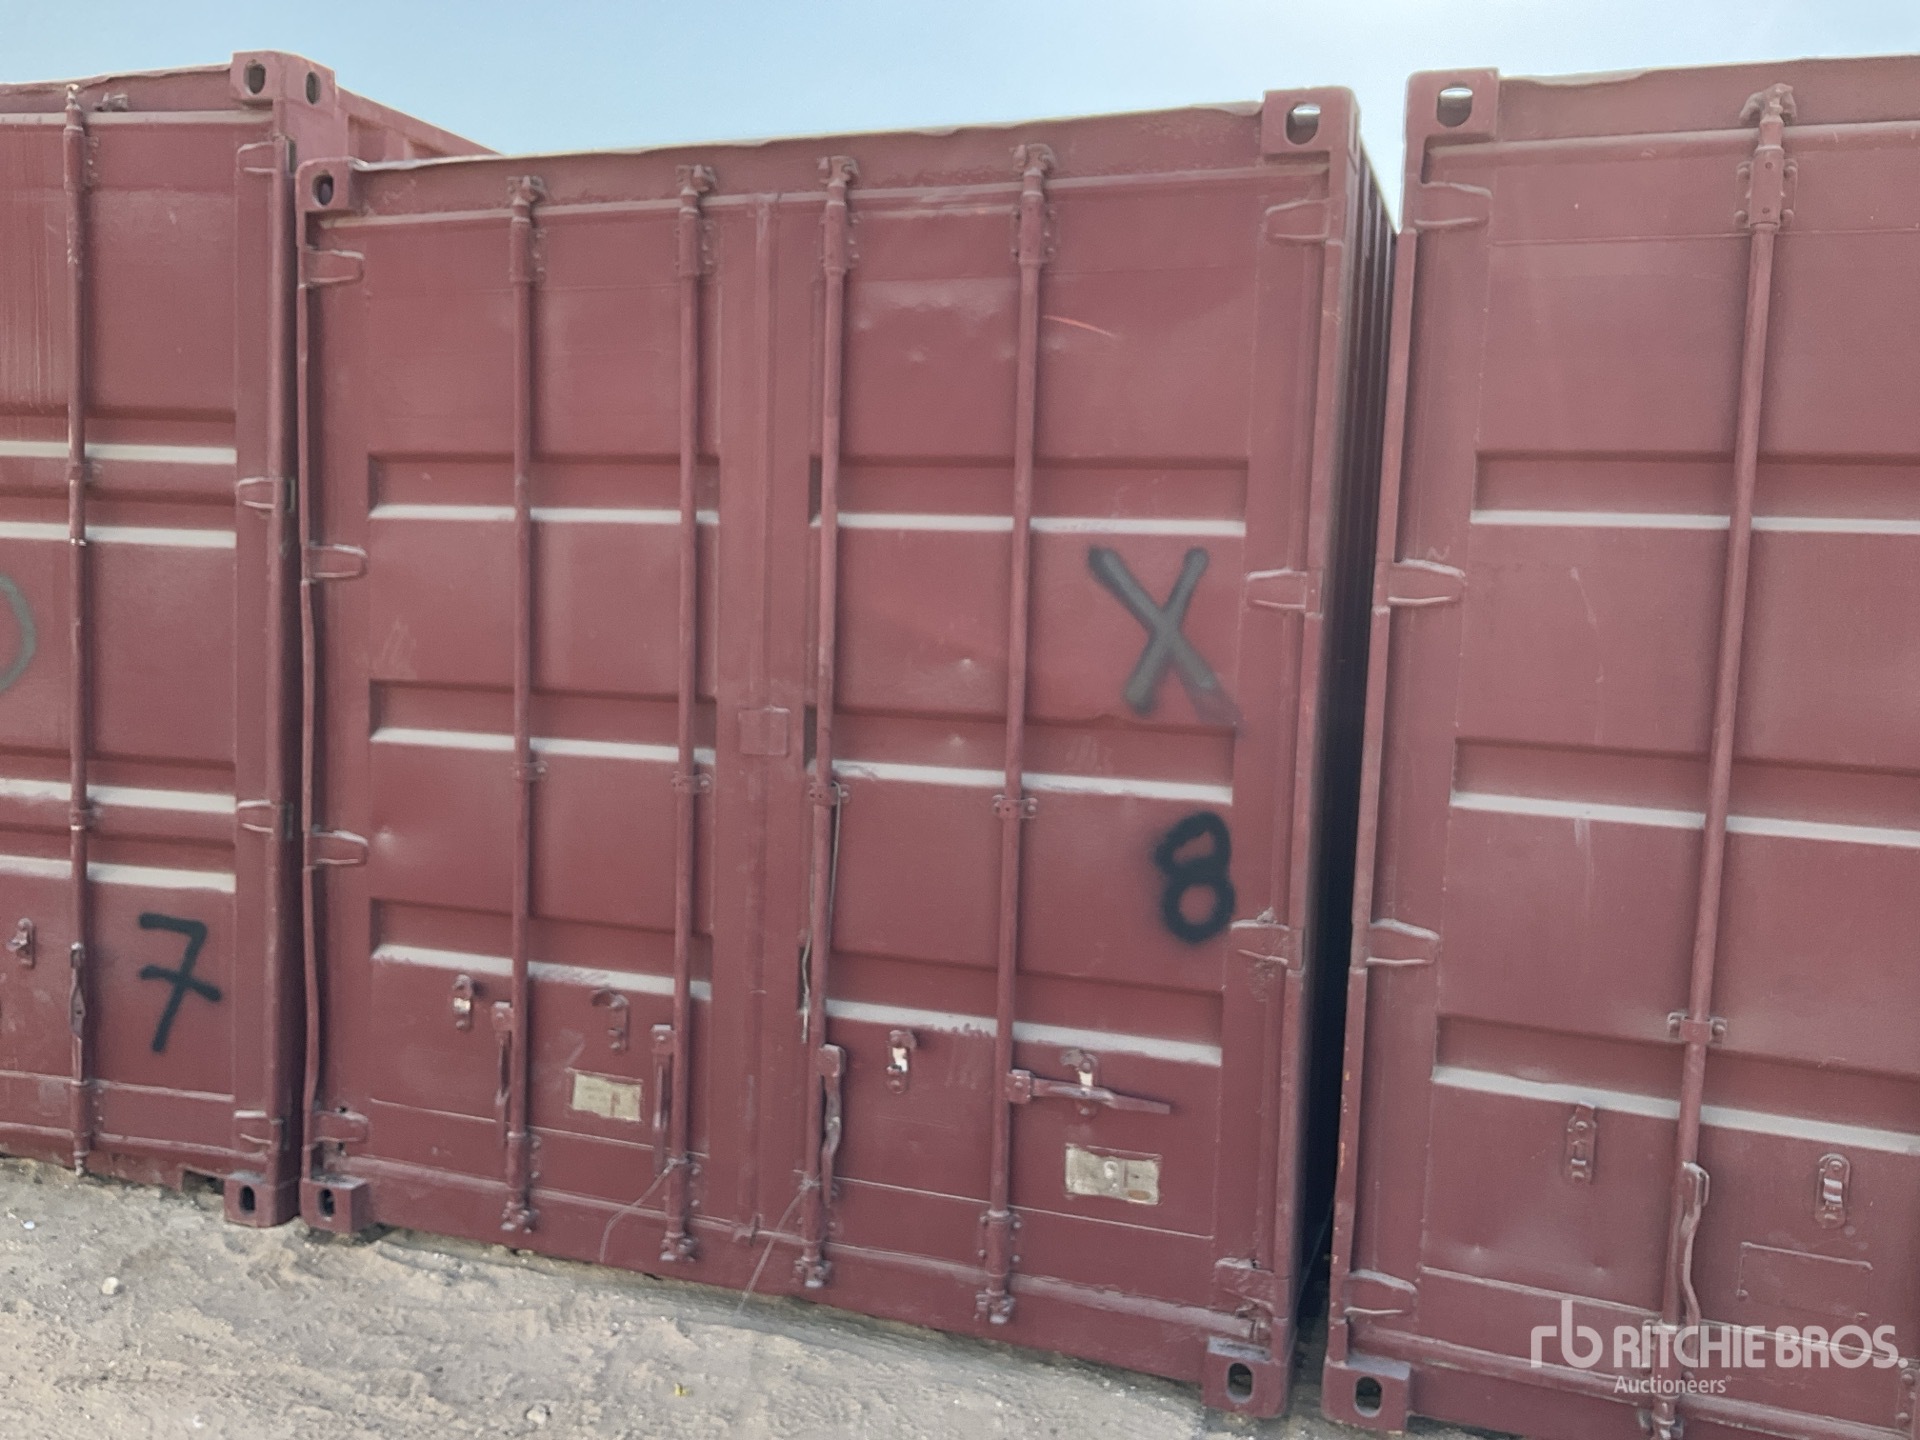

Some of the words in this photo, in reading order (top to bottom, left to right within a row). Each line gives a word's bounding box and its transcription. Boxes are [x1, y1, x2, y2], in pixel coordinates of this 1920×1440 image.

[1088, 546, 1242, 735] X
[1154, 810, 1236, 946] 8
[138, 912, 222, 1053] 7
